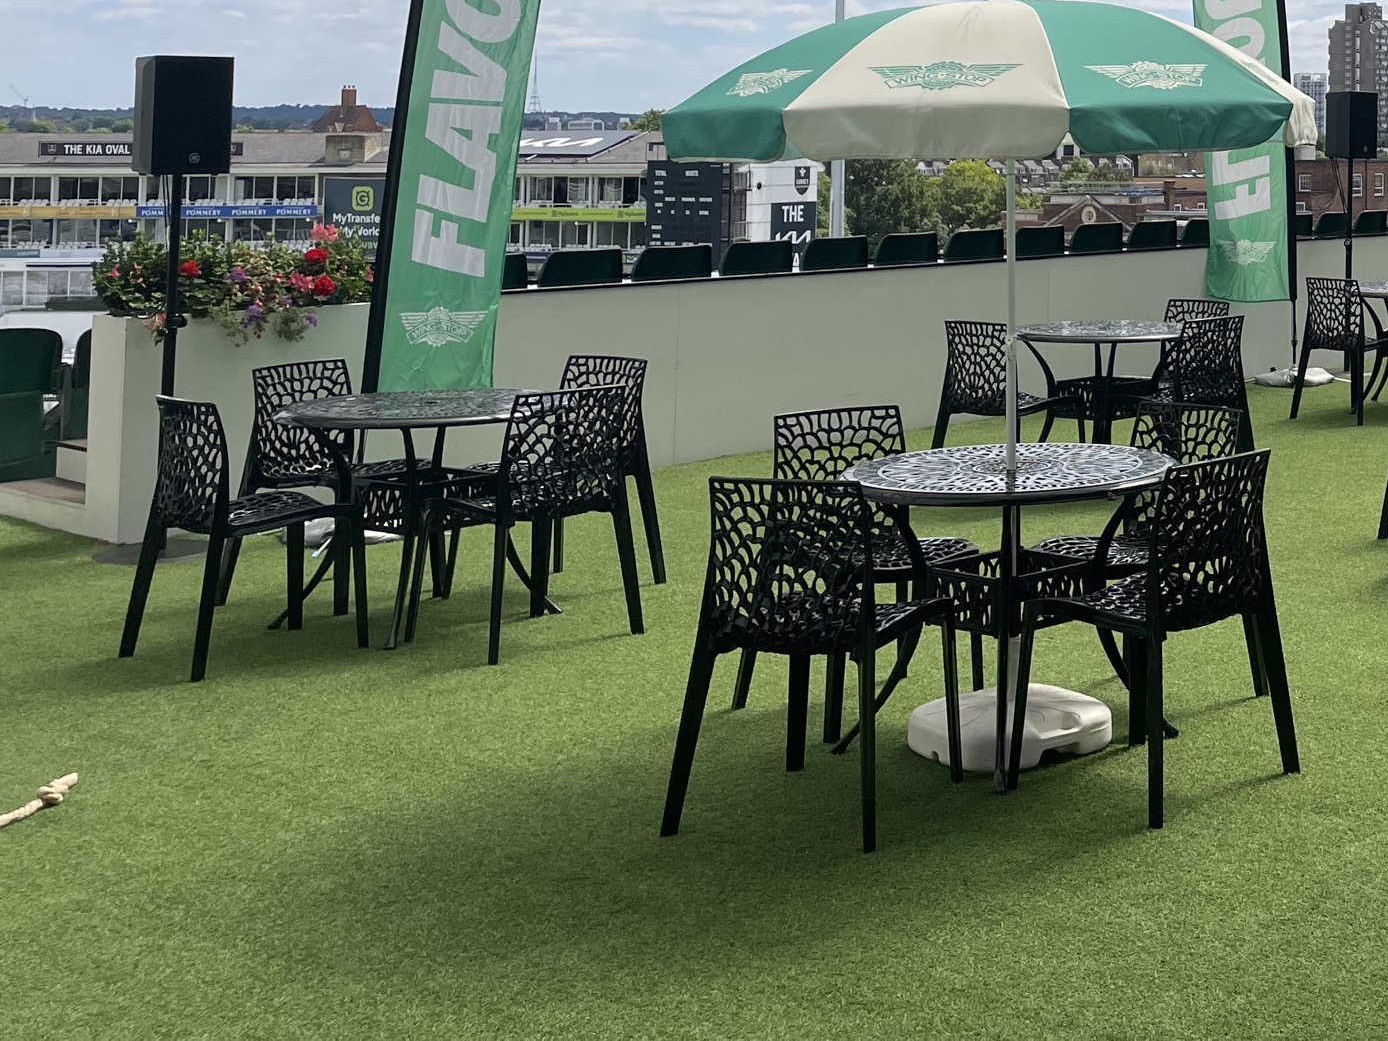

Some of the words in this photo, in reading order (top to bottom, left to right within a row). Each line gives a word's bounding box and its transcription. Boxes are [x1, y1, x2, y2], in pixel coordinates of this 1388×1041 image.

[63, 143, 83, 155] THE
[85, 143, 103, 155] KIA
[105, 143, 131, 155] OVAL
[276, 208, 312, 216] POMMERY
[781, 204, 805, 223] THE
[332, 212, 381, 225] MyTransfe
